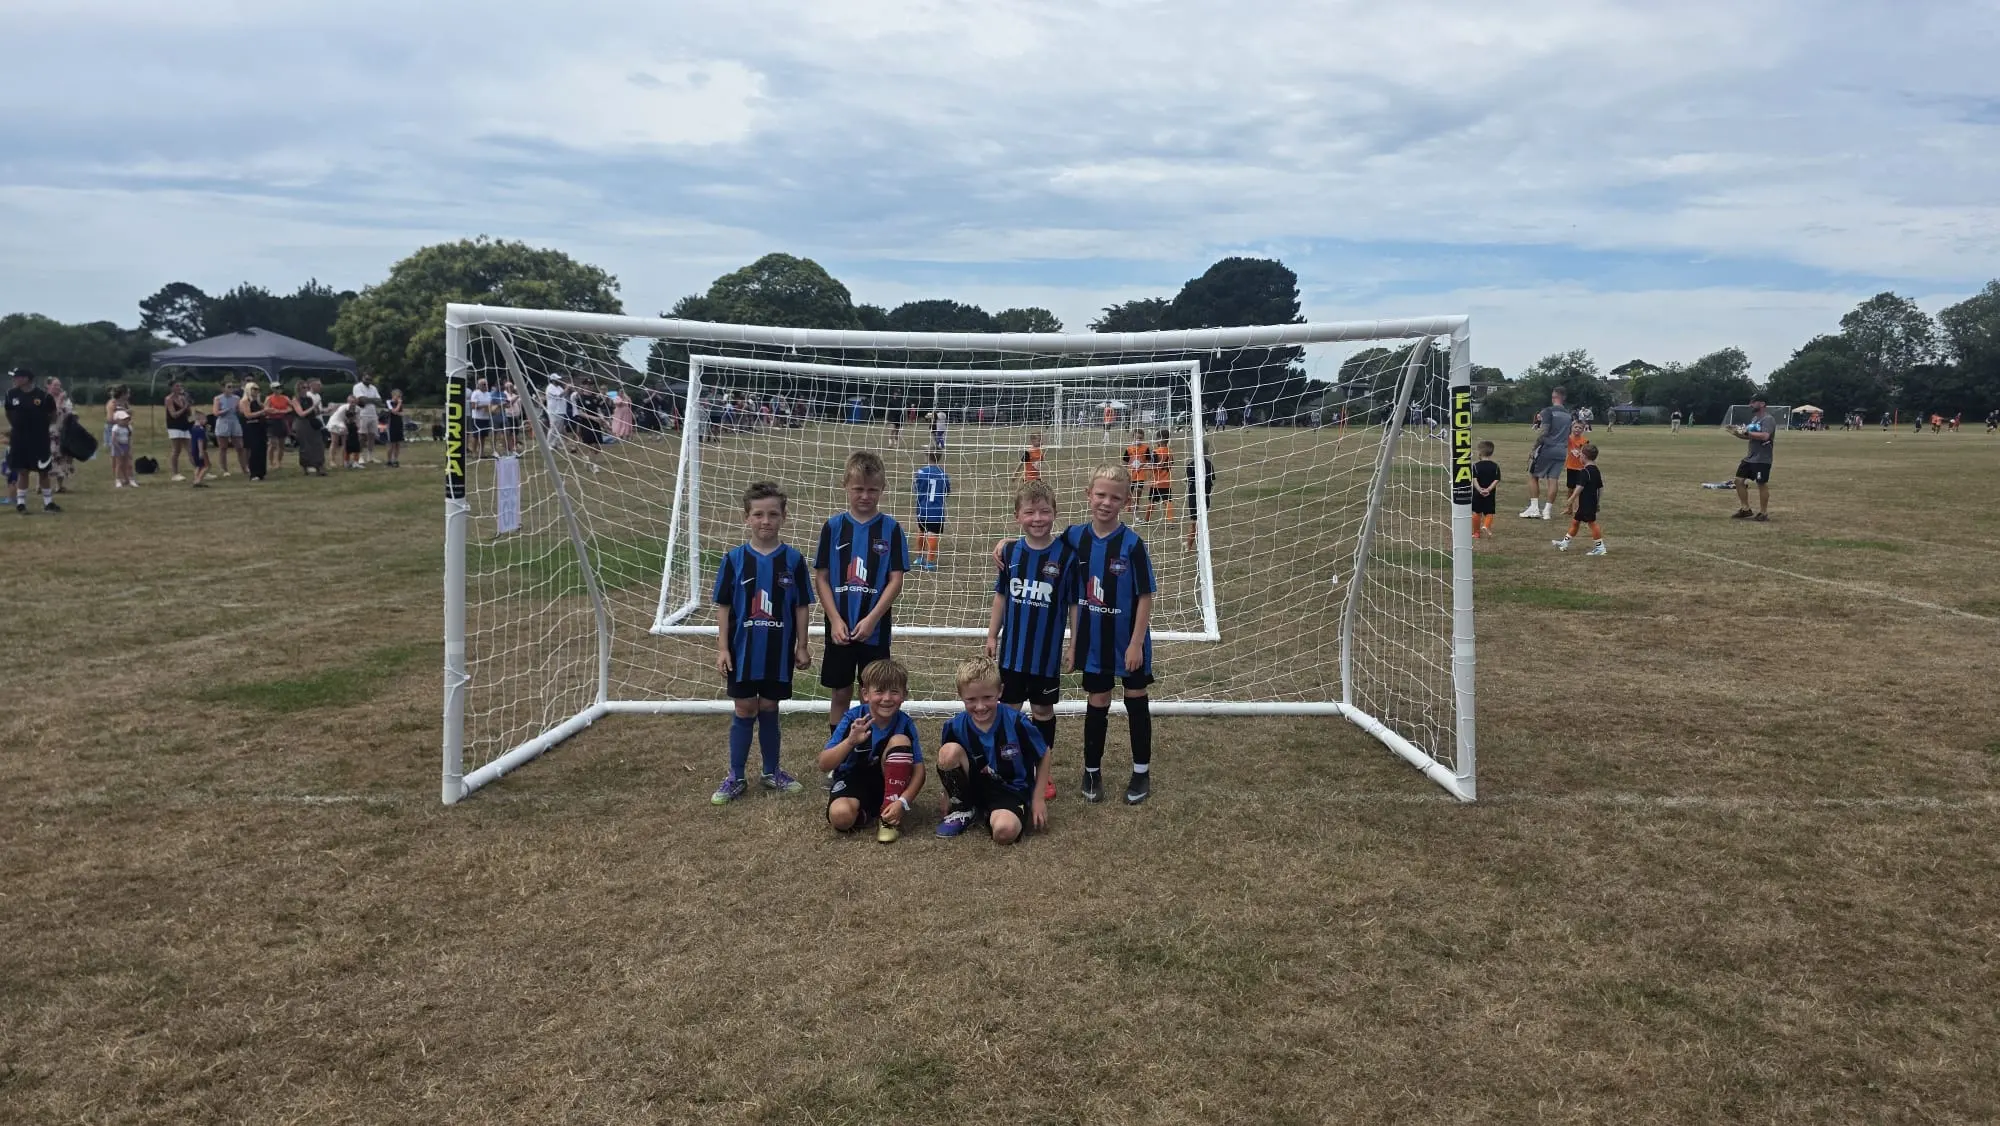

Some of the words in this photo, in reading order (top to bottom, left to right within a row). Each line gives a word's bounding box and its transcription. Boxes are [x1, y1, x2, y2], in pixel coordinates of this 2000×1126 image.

[446, 383, 463, 476] FORZA
[1455, 393, 1471, 483] FORZA
[930, 479, 936, 502] 1
[1010, 577, 1053, 602] CHR
[1089, 605, 1122, 614] GROUP
